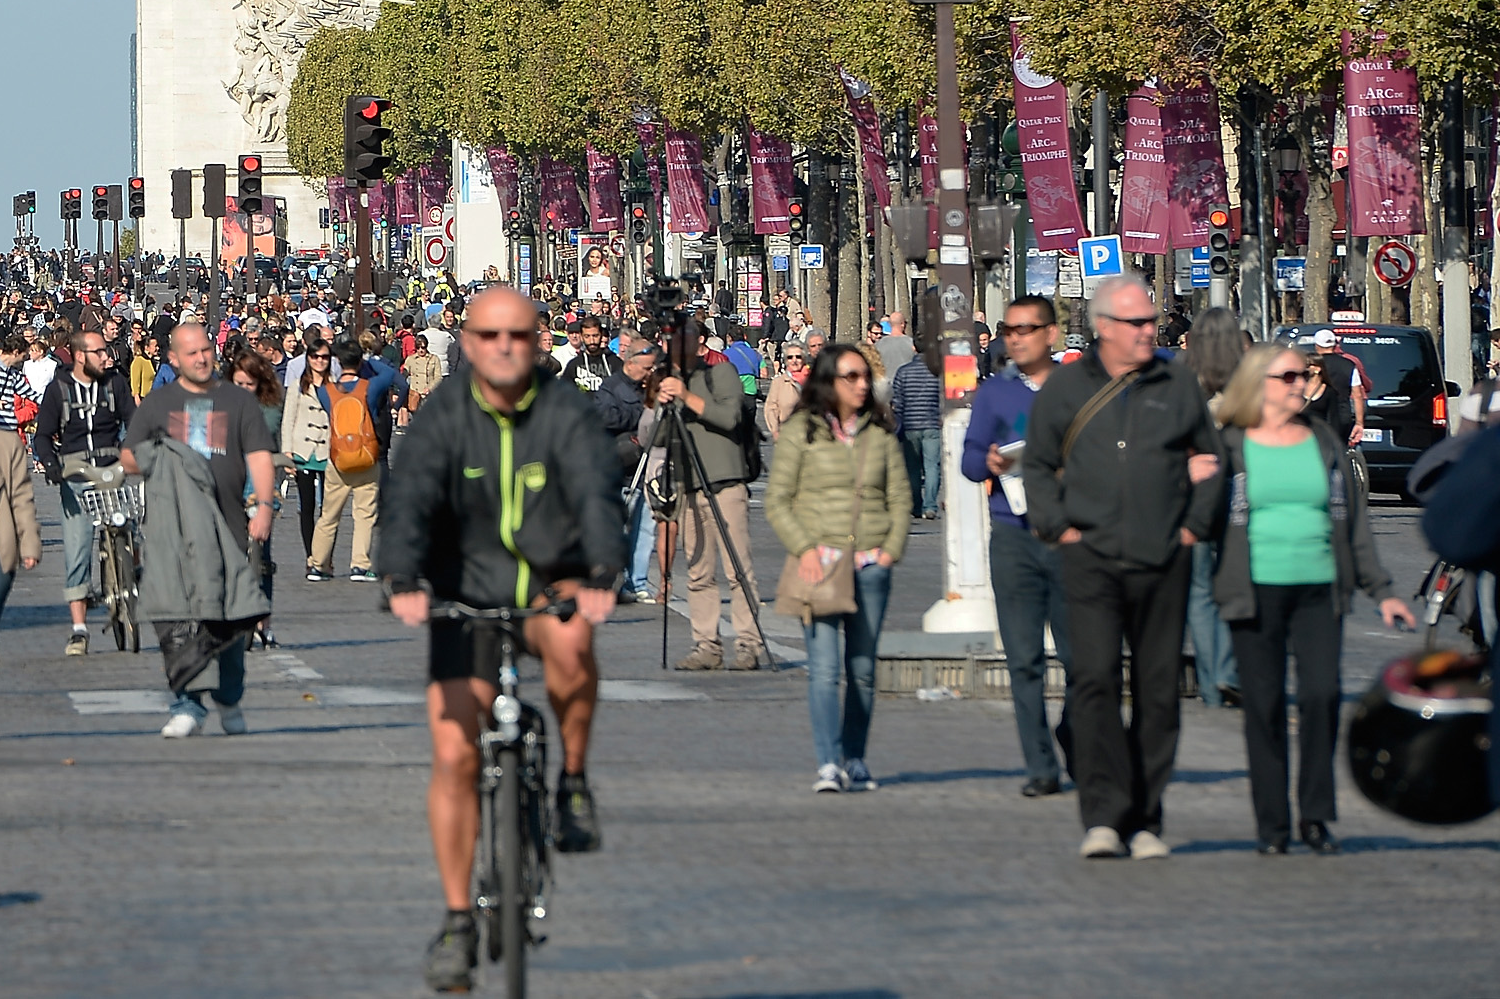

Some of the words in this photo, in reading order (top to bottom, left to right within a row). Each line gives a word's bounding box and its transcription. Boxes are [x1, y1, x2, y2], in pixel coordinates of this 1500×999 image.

[1350, 61, 1383, 73] QATAR
[1359, 87, 1394, 99] L'ARC
[1348, 104, 1417, 117] TRIOMPHE
[1018, 118, 1042, 128] QATAR
[1044, 116, 1062, 124] PRIX
[1129, 116, 1156, 127] QATAR
[751, 155, 791, 164] TRIOMPHE
[1020, 149, 1067, 162] TRIOMPHE
[1371, 216, 1407, 224] GALOP
[1092, 245, 1110, 270] P
